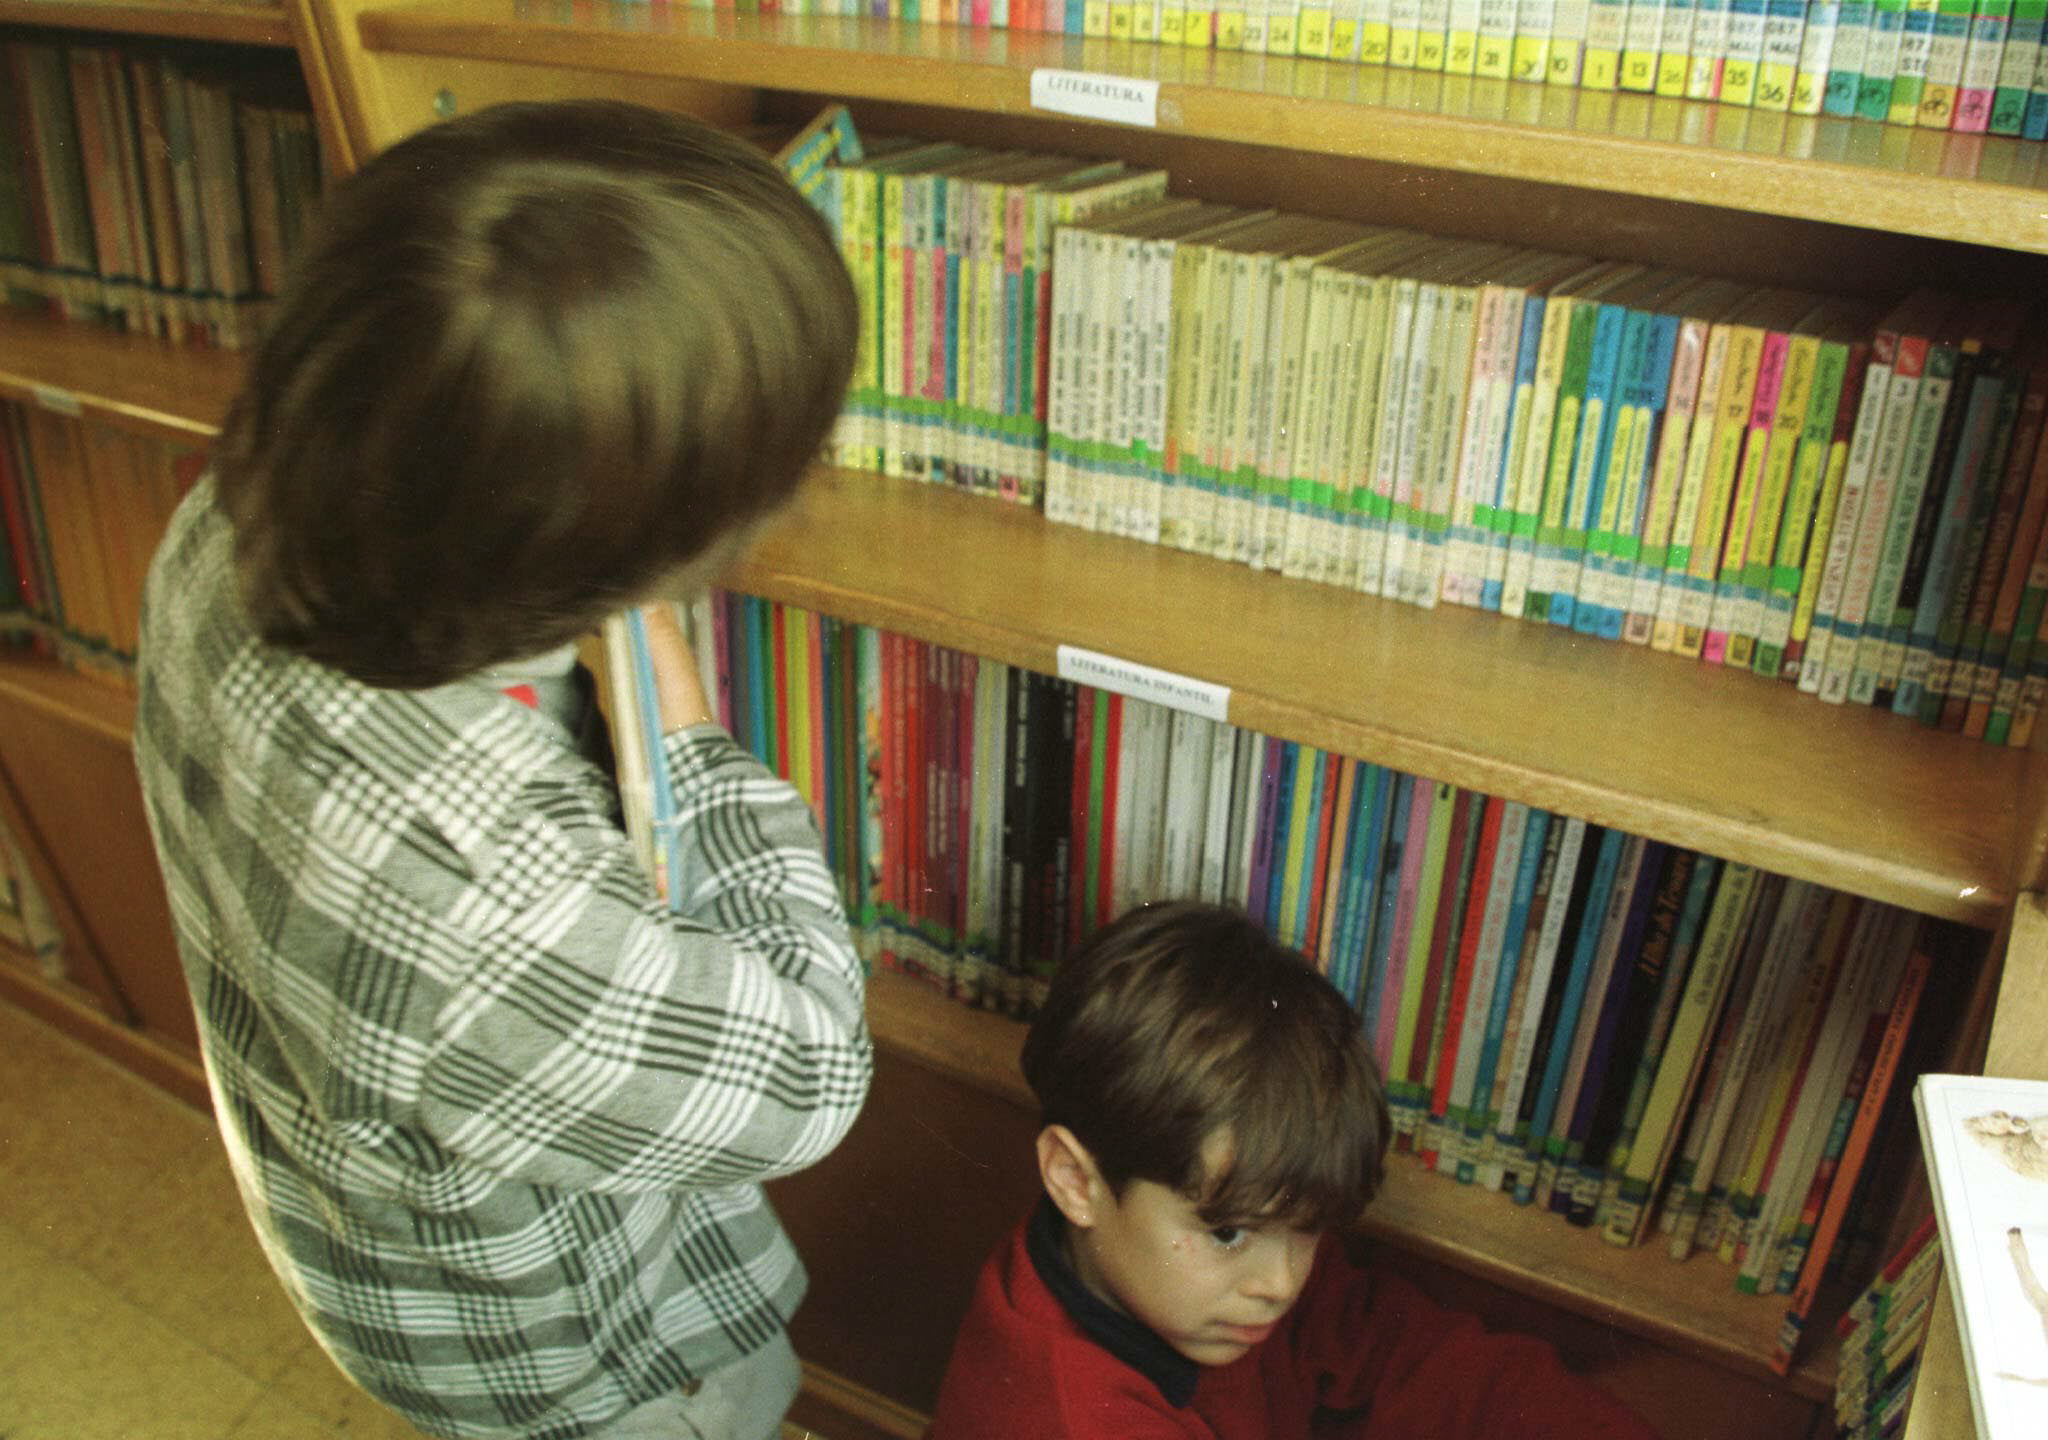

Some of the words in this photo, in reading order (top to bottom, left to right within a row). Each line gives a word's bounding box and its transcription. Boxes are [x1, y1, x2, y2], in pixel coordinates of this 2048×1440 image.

[1726, 68, 1747, 86] 35
[1048, 76, 1144, 103] LITERATURA
[1759, 83, 1784, 102] 36
[1070, 656, 1150, 687] LITERATURA
[1152, 680, 1214, 705] INFANTIL
